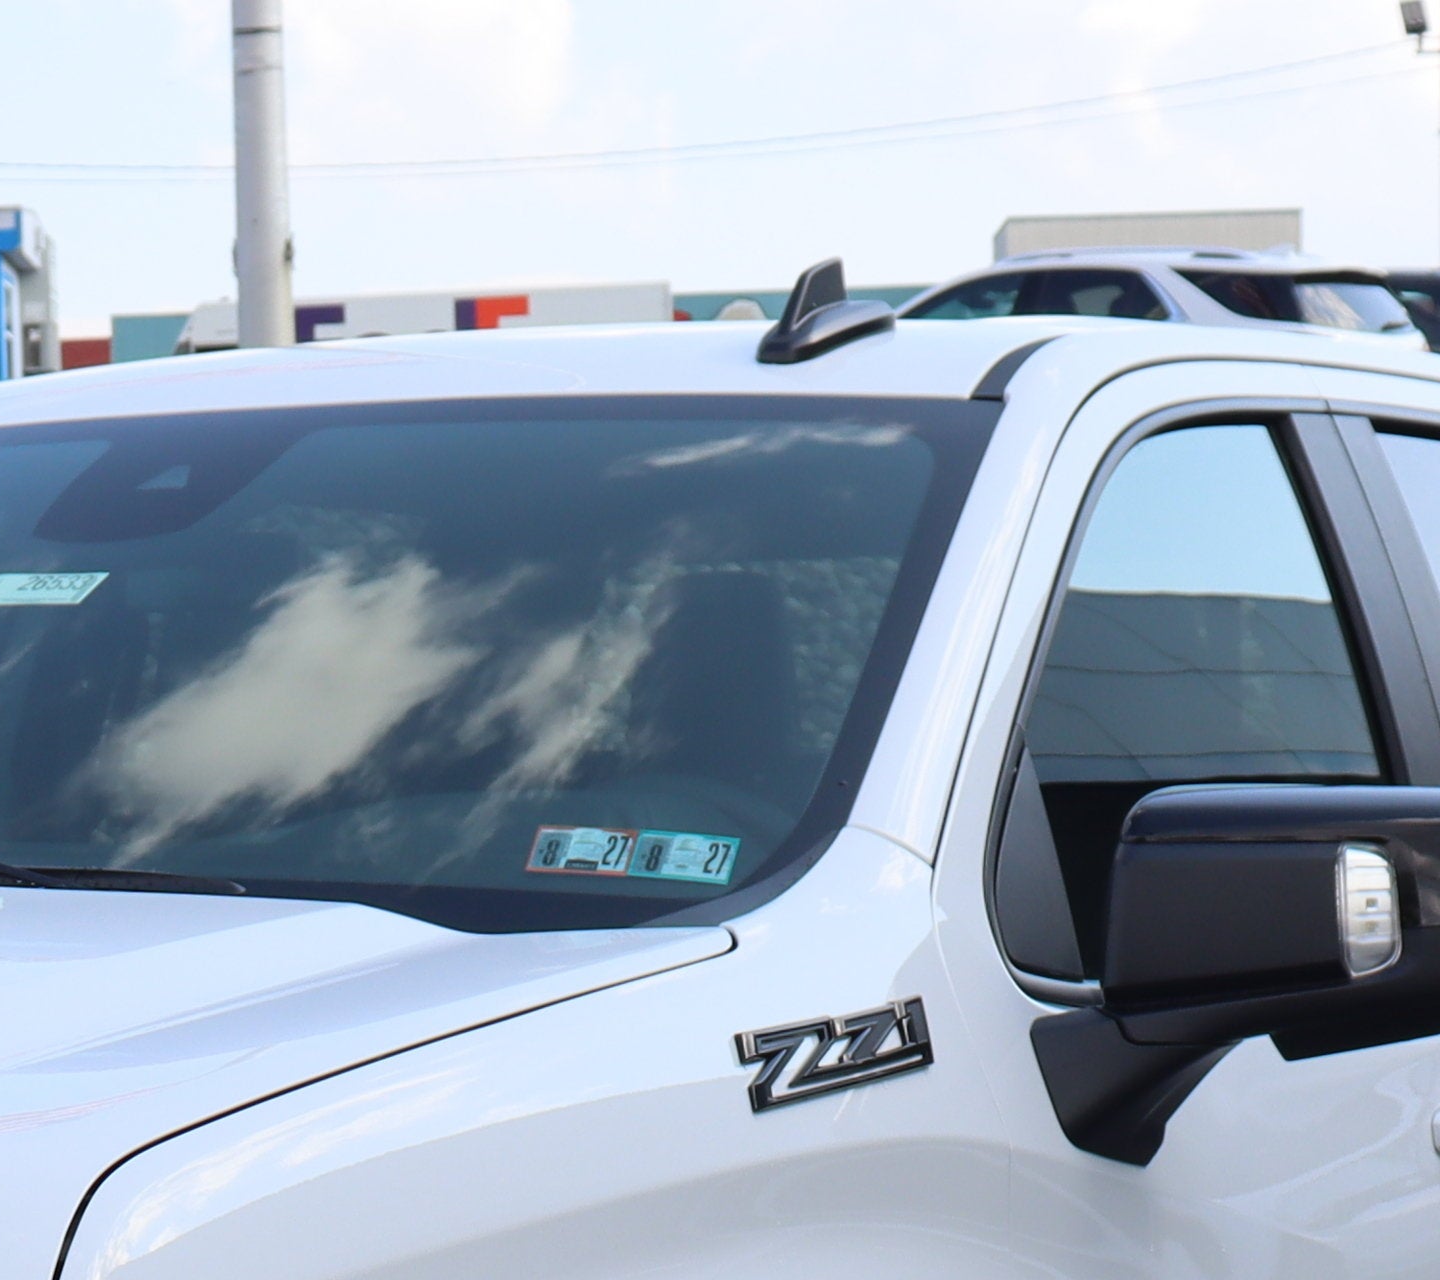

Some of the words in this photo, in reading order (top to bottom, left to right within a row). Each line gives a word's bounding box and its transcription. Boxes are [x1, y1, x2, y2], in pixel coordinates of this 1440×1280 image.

[16, 574, 97, 591] 26533
[541, 838, 560, 867] 8
[601, 835, 631, 869] 27
[644, 843, 663, 872] 8
[702, 842, 733, 876] 27
[732, 994, 935, 1114] Z71
